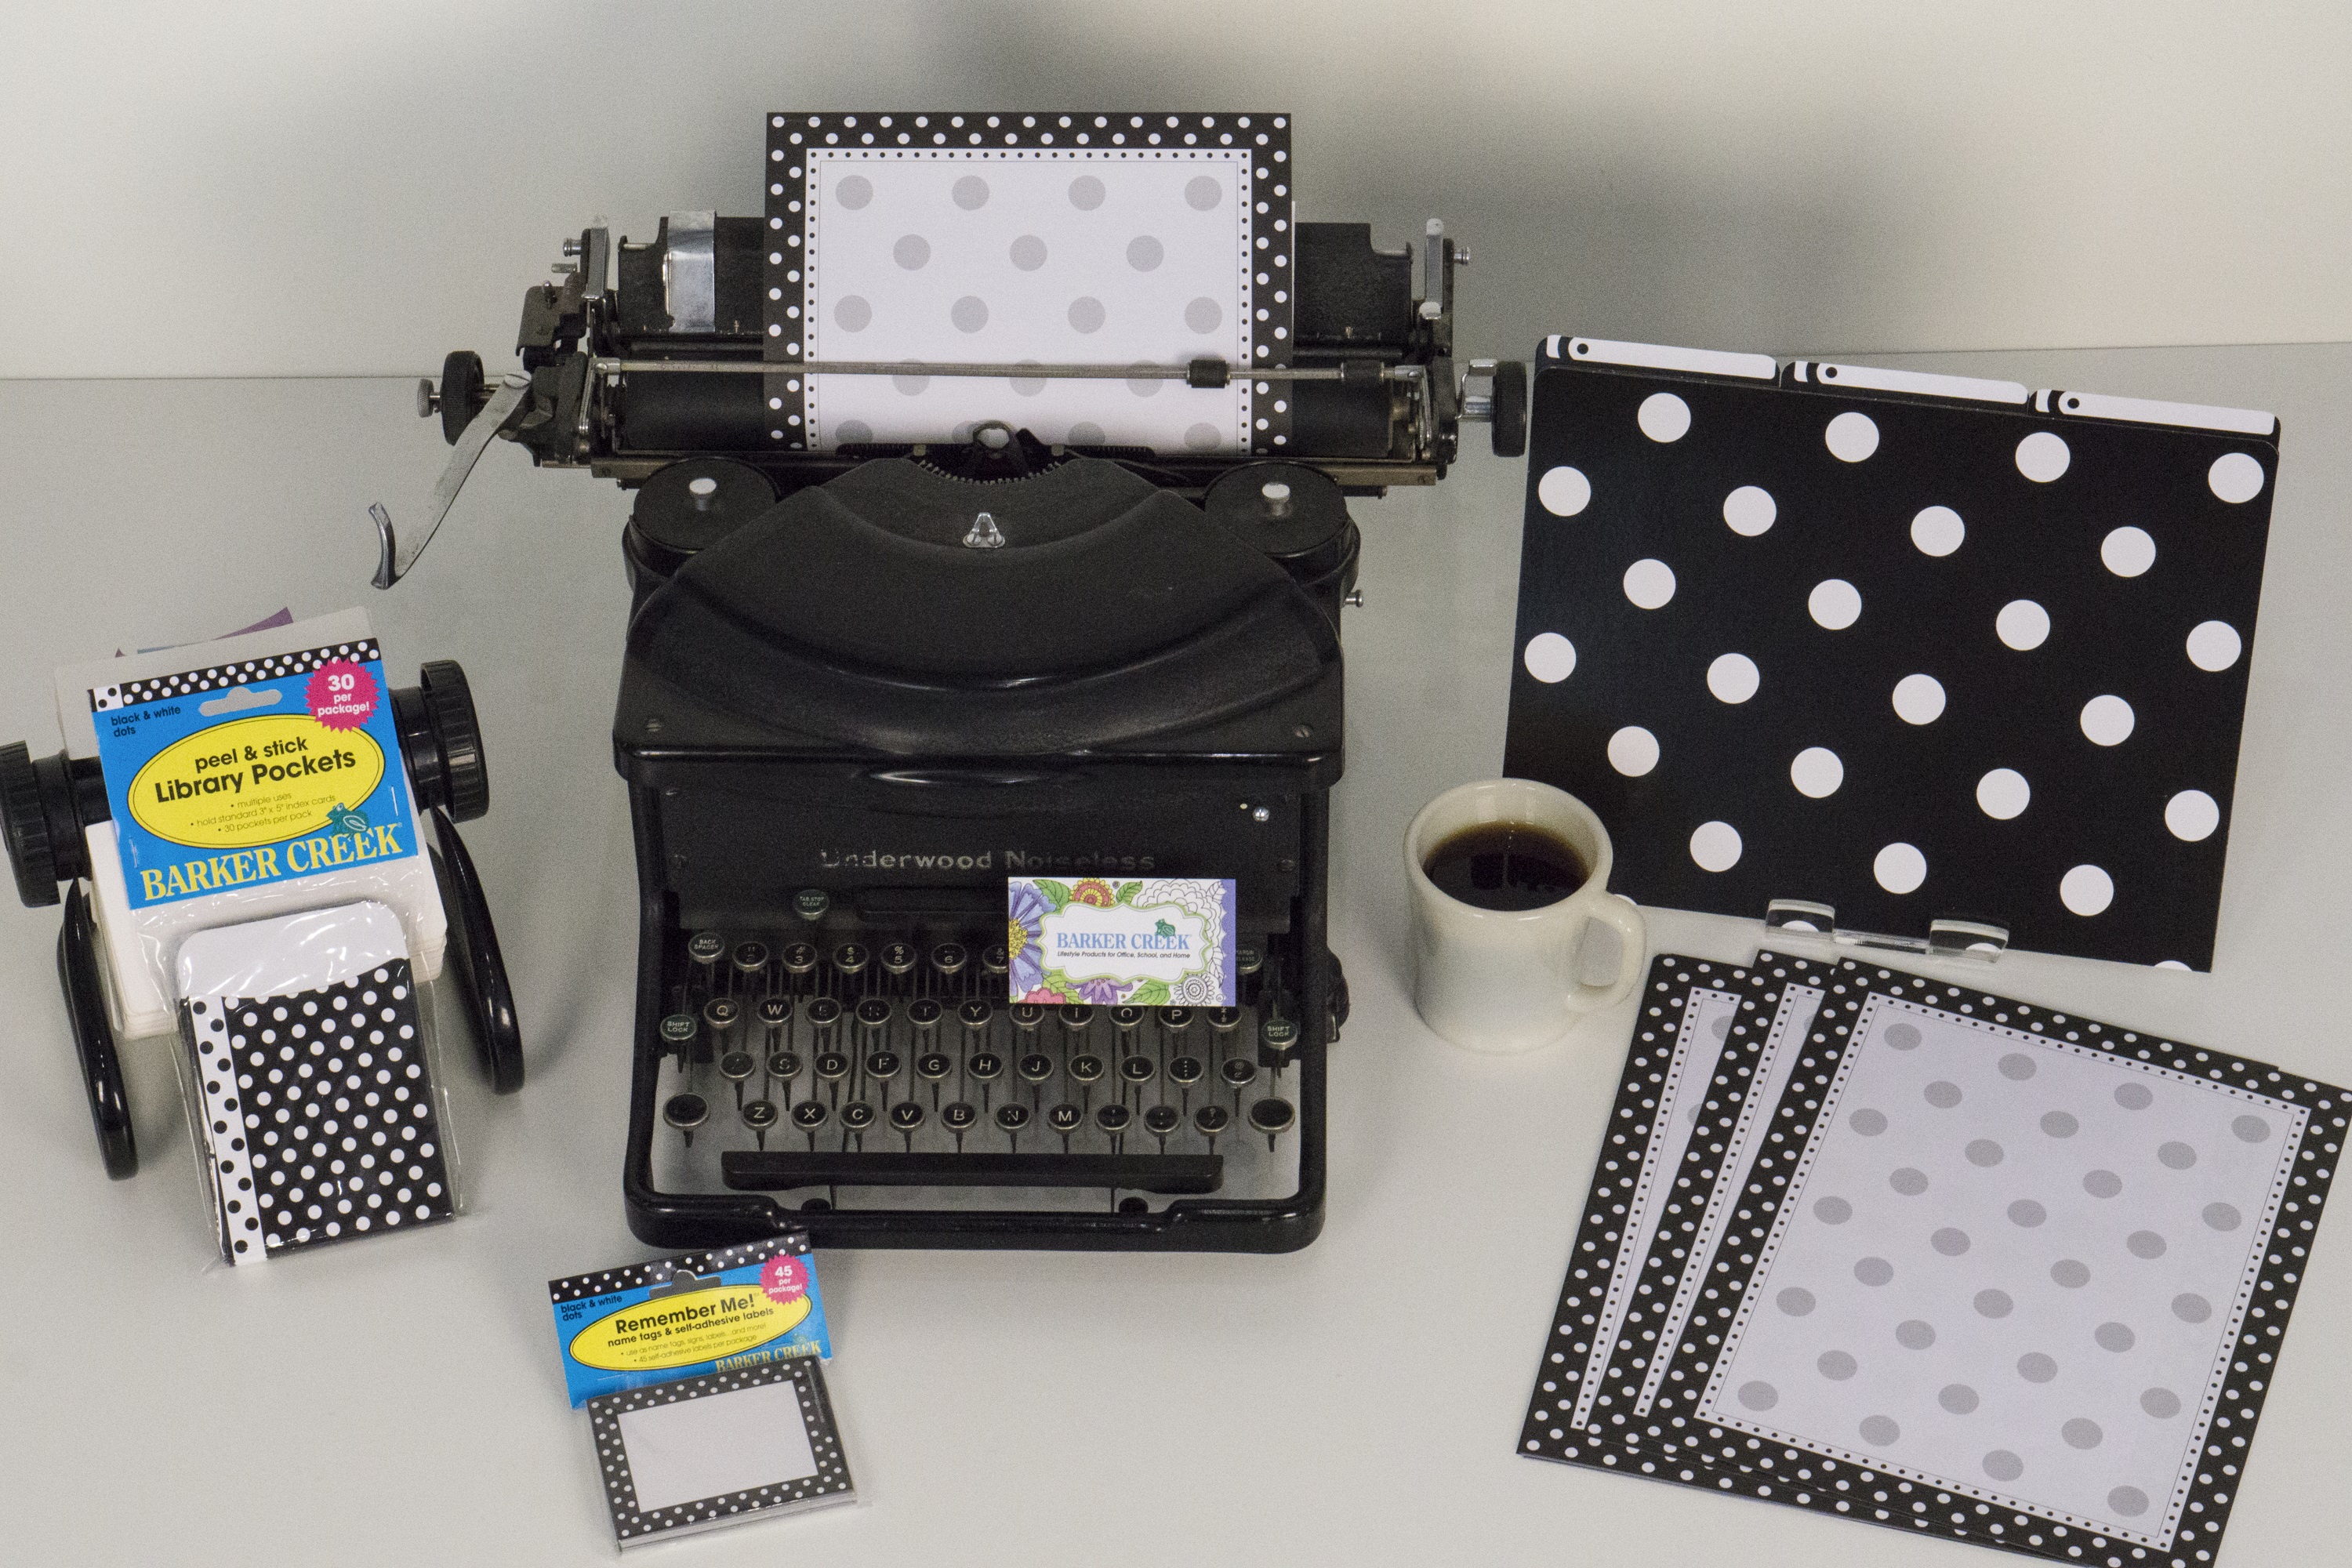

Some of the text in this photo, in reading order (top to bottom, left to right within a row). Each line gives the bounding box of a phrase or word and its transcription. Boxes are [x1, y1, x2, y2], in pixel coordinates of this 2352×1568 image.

[328, 673, 354, 691] 30
[333, 693, 352, 705] per
[318, 701, 370, 717] package!
[111, 706, 181, 726] black & white
[114, 726, 136, 738] dots
[195, 736, 309, 774] peel & stick
[155, 750, 357, 804] Library Pockets
[237, 792, 292, 808] multiple uses
[197, 817, 217, 827] hold
[218, 808, 258, 823] standard
[259, 804, 268, 815] 3"
[275, 804, 284, 813] 5"
[285, 800, 310, 811] index
[311, 794, 336, 806] cards
[224, 810, 312, 833] 30 pockets per pack
[140, 823, 403, 901] BARKER CREEK
[820, 849, 993, 869] Underwood
[1057, 932, 1190, 950] BARKER CREEK
[717, 1005, 728, 1017] Q
[768, 1004, 782, 1015] W
[970, 1006, 982, 1017] Y
[1022, 1007, 1033, 1018] U
[1171, 1009, 1182, 1020] P
[826, 1059, 838, 1071] D
[878, 1058, 890, 1069] F
[928, 1059, 939, 1071] G
[978, 1059, 991, 1071] H
[1031, 1061, 1040, 1072] J
[1081, 1062, 1092, 1073] K
[1132, 1063, 1143, 1075] L
[753, 1107, 765, 1119] Z
[804, 1108, 816, 1119] X
[852, 1109, 863, 1120] C
[902, 1109, 913, 1120] V
[953, 1109, 965, 1121] B
[1058, 1110, 1072, 1122] M
[775, 1265, 793, 1277] 45
[768, 1283, 803, 1294] package!
[561, 1301, 586, 1314] black
[598, 1294, 622, 1306] white
[562, 1312, 583, 1321] dots
[615, 1294, 755, 1334] Remember Me!
[608, 1307, 774, 1347] name tags & self-adhesive labels
[648, 1343, 669, 1352] name
[649, 1348, 691, 1362] self-adhesive
[692, 1341, 713, 1354] labels
[713, 1341, 724, 1350] per
[726, 1334, 757, 1347] package
[715, 1340, 822, 1372] BARKER CREEK
